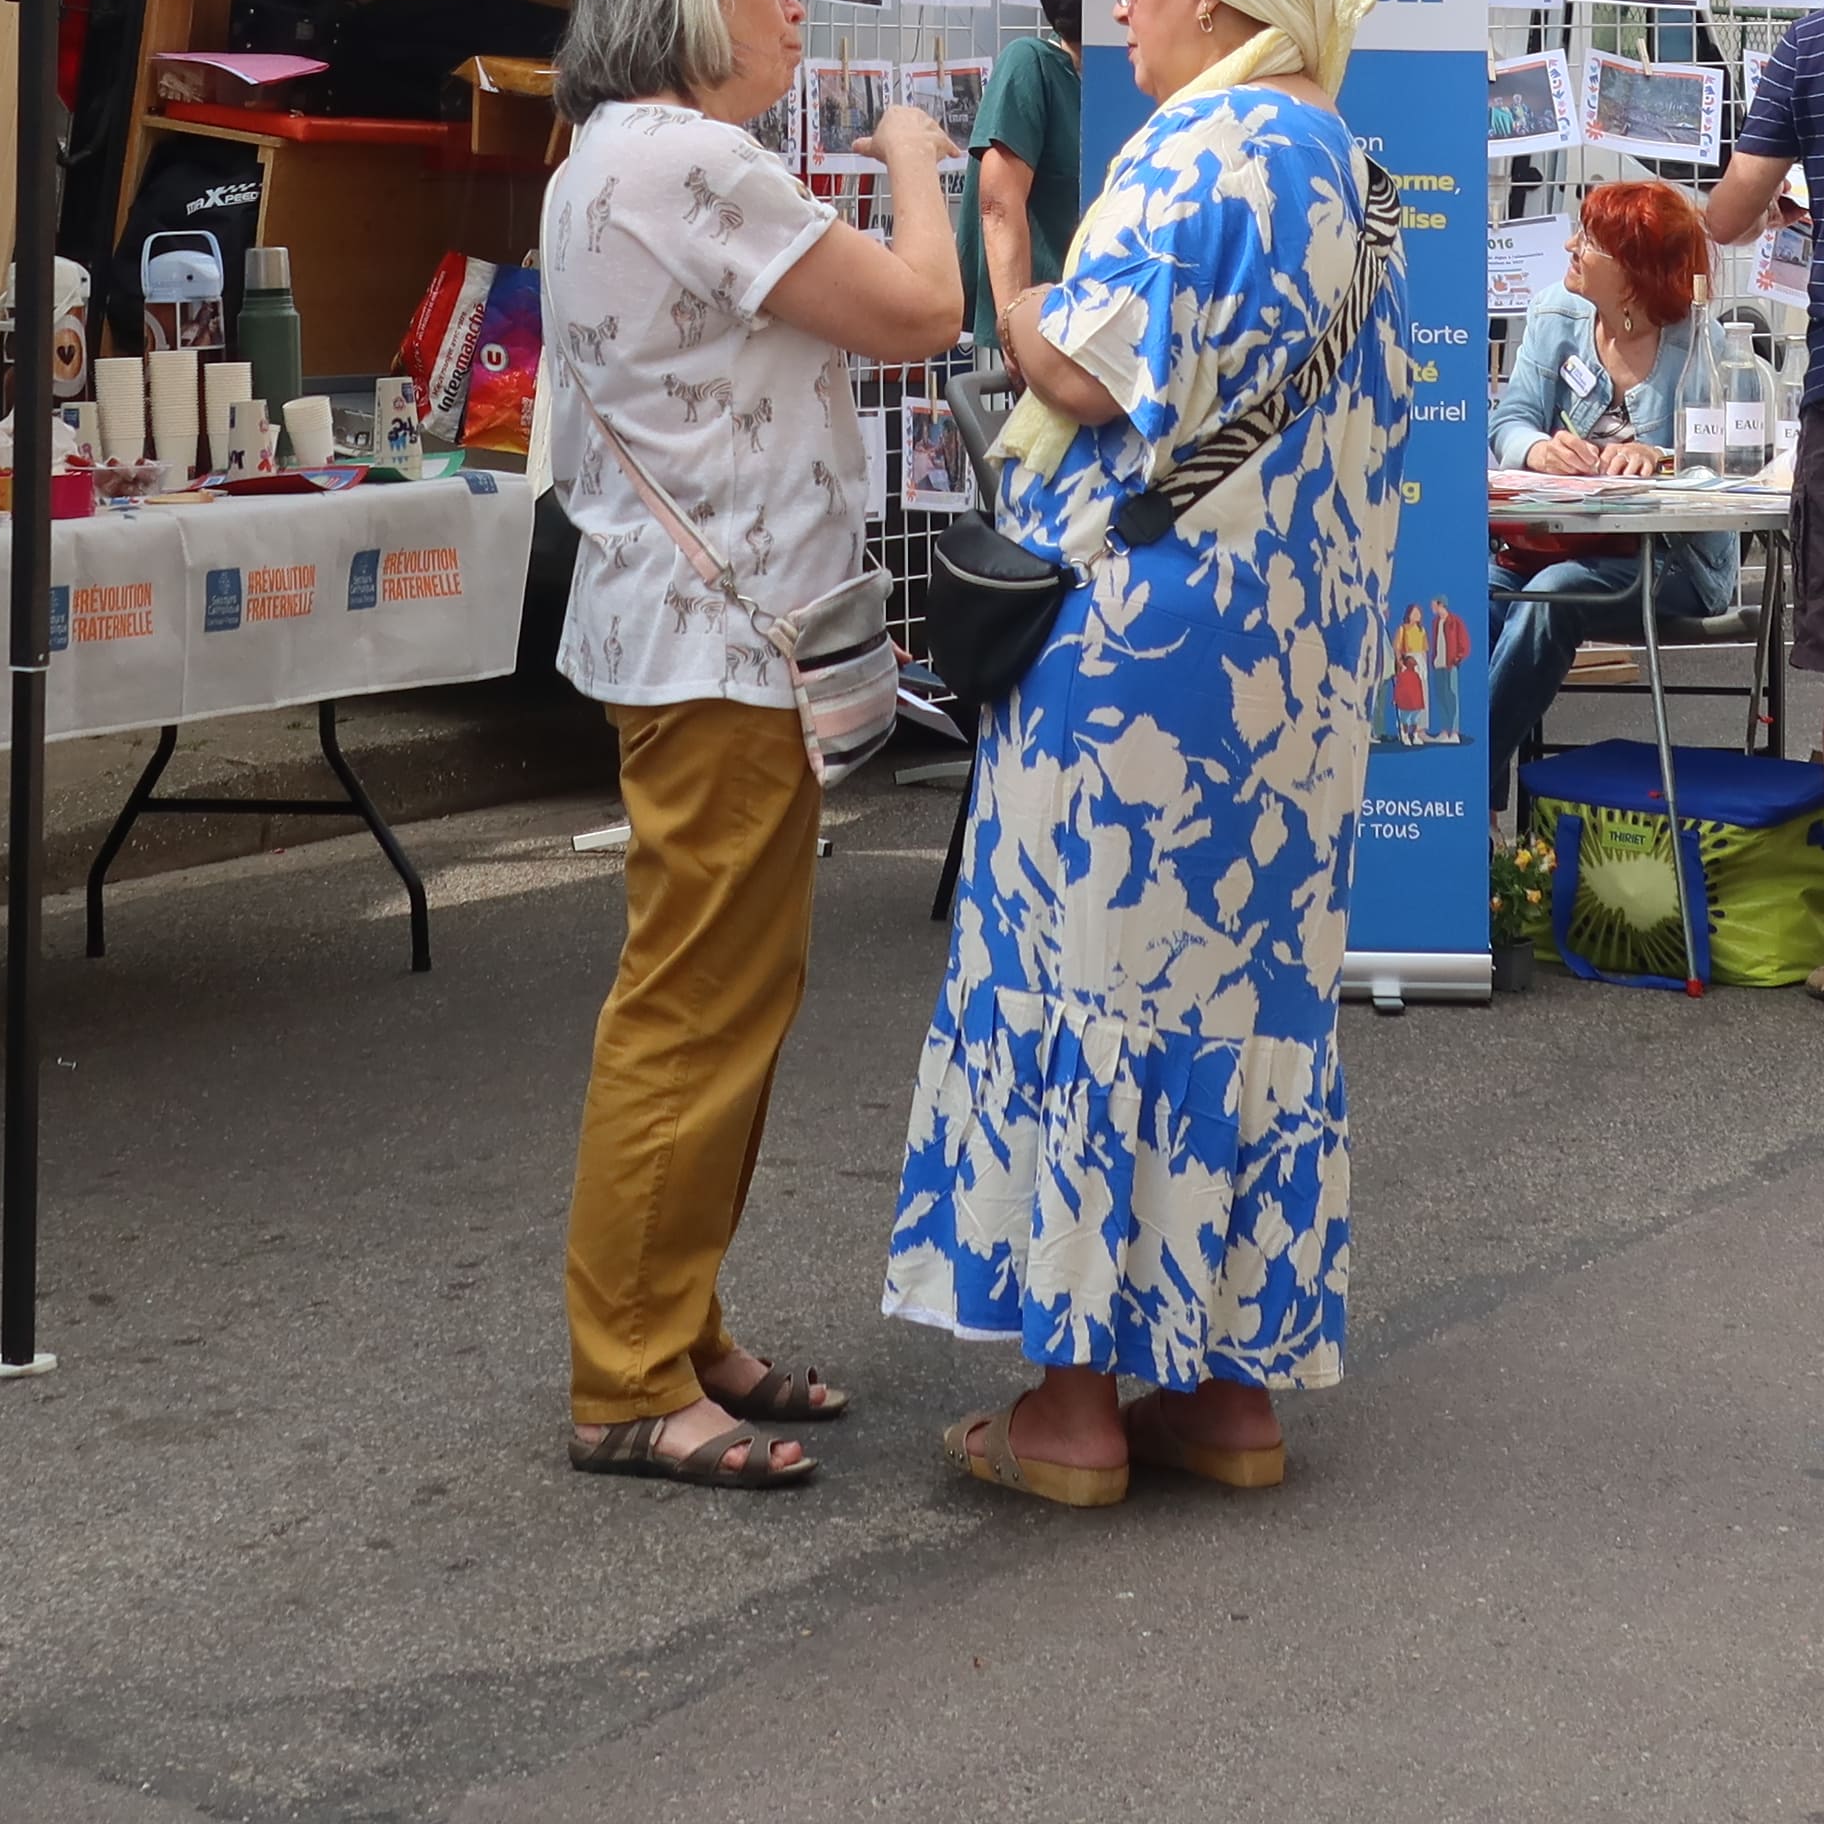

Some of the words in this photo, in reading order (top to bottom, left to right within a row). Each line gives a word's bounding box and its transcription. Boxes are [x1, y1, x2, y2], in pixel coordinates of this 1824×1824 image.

[1353, 136, 1384, 152] on
[1385, 169, 1460, 195] orme,
[1400, 206, 1447, 229] lise
[1411, 322, 1468, 344] forte
[1412, 360, 1439, 382] té
[1694, 423, 1720, 435] EAU
[1735, 419, 1760, 431] EAU
[382, 547, 459, 575] #RÉVOLUTION
[247, 564, 316, 595] #RÉVOLUTION
[382, 572, 462, 602] FRATERNELLE
[72, 582, 152, 615] #RÉVOLUTION
[246, 591, 315, 622] FRATERNELLE
[71, 611, 153, 643] FRATERNELLE
[1362, 799, 1464, 817] SPONSABLE
[1370, 823, 1420, 839] TOUS
